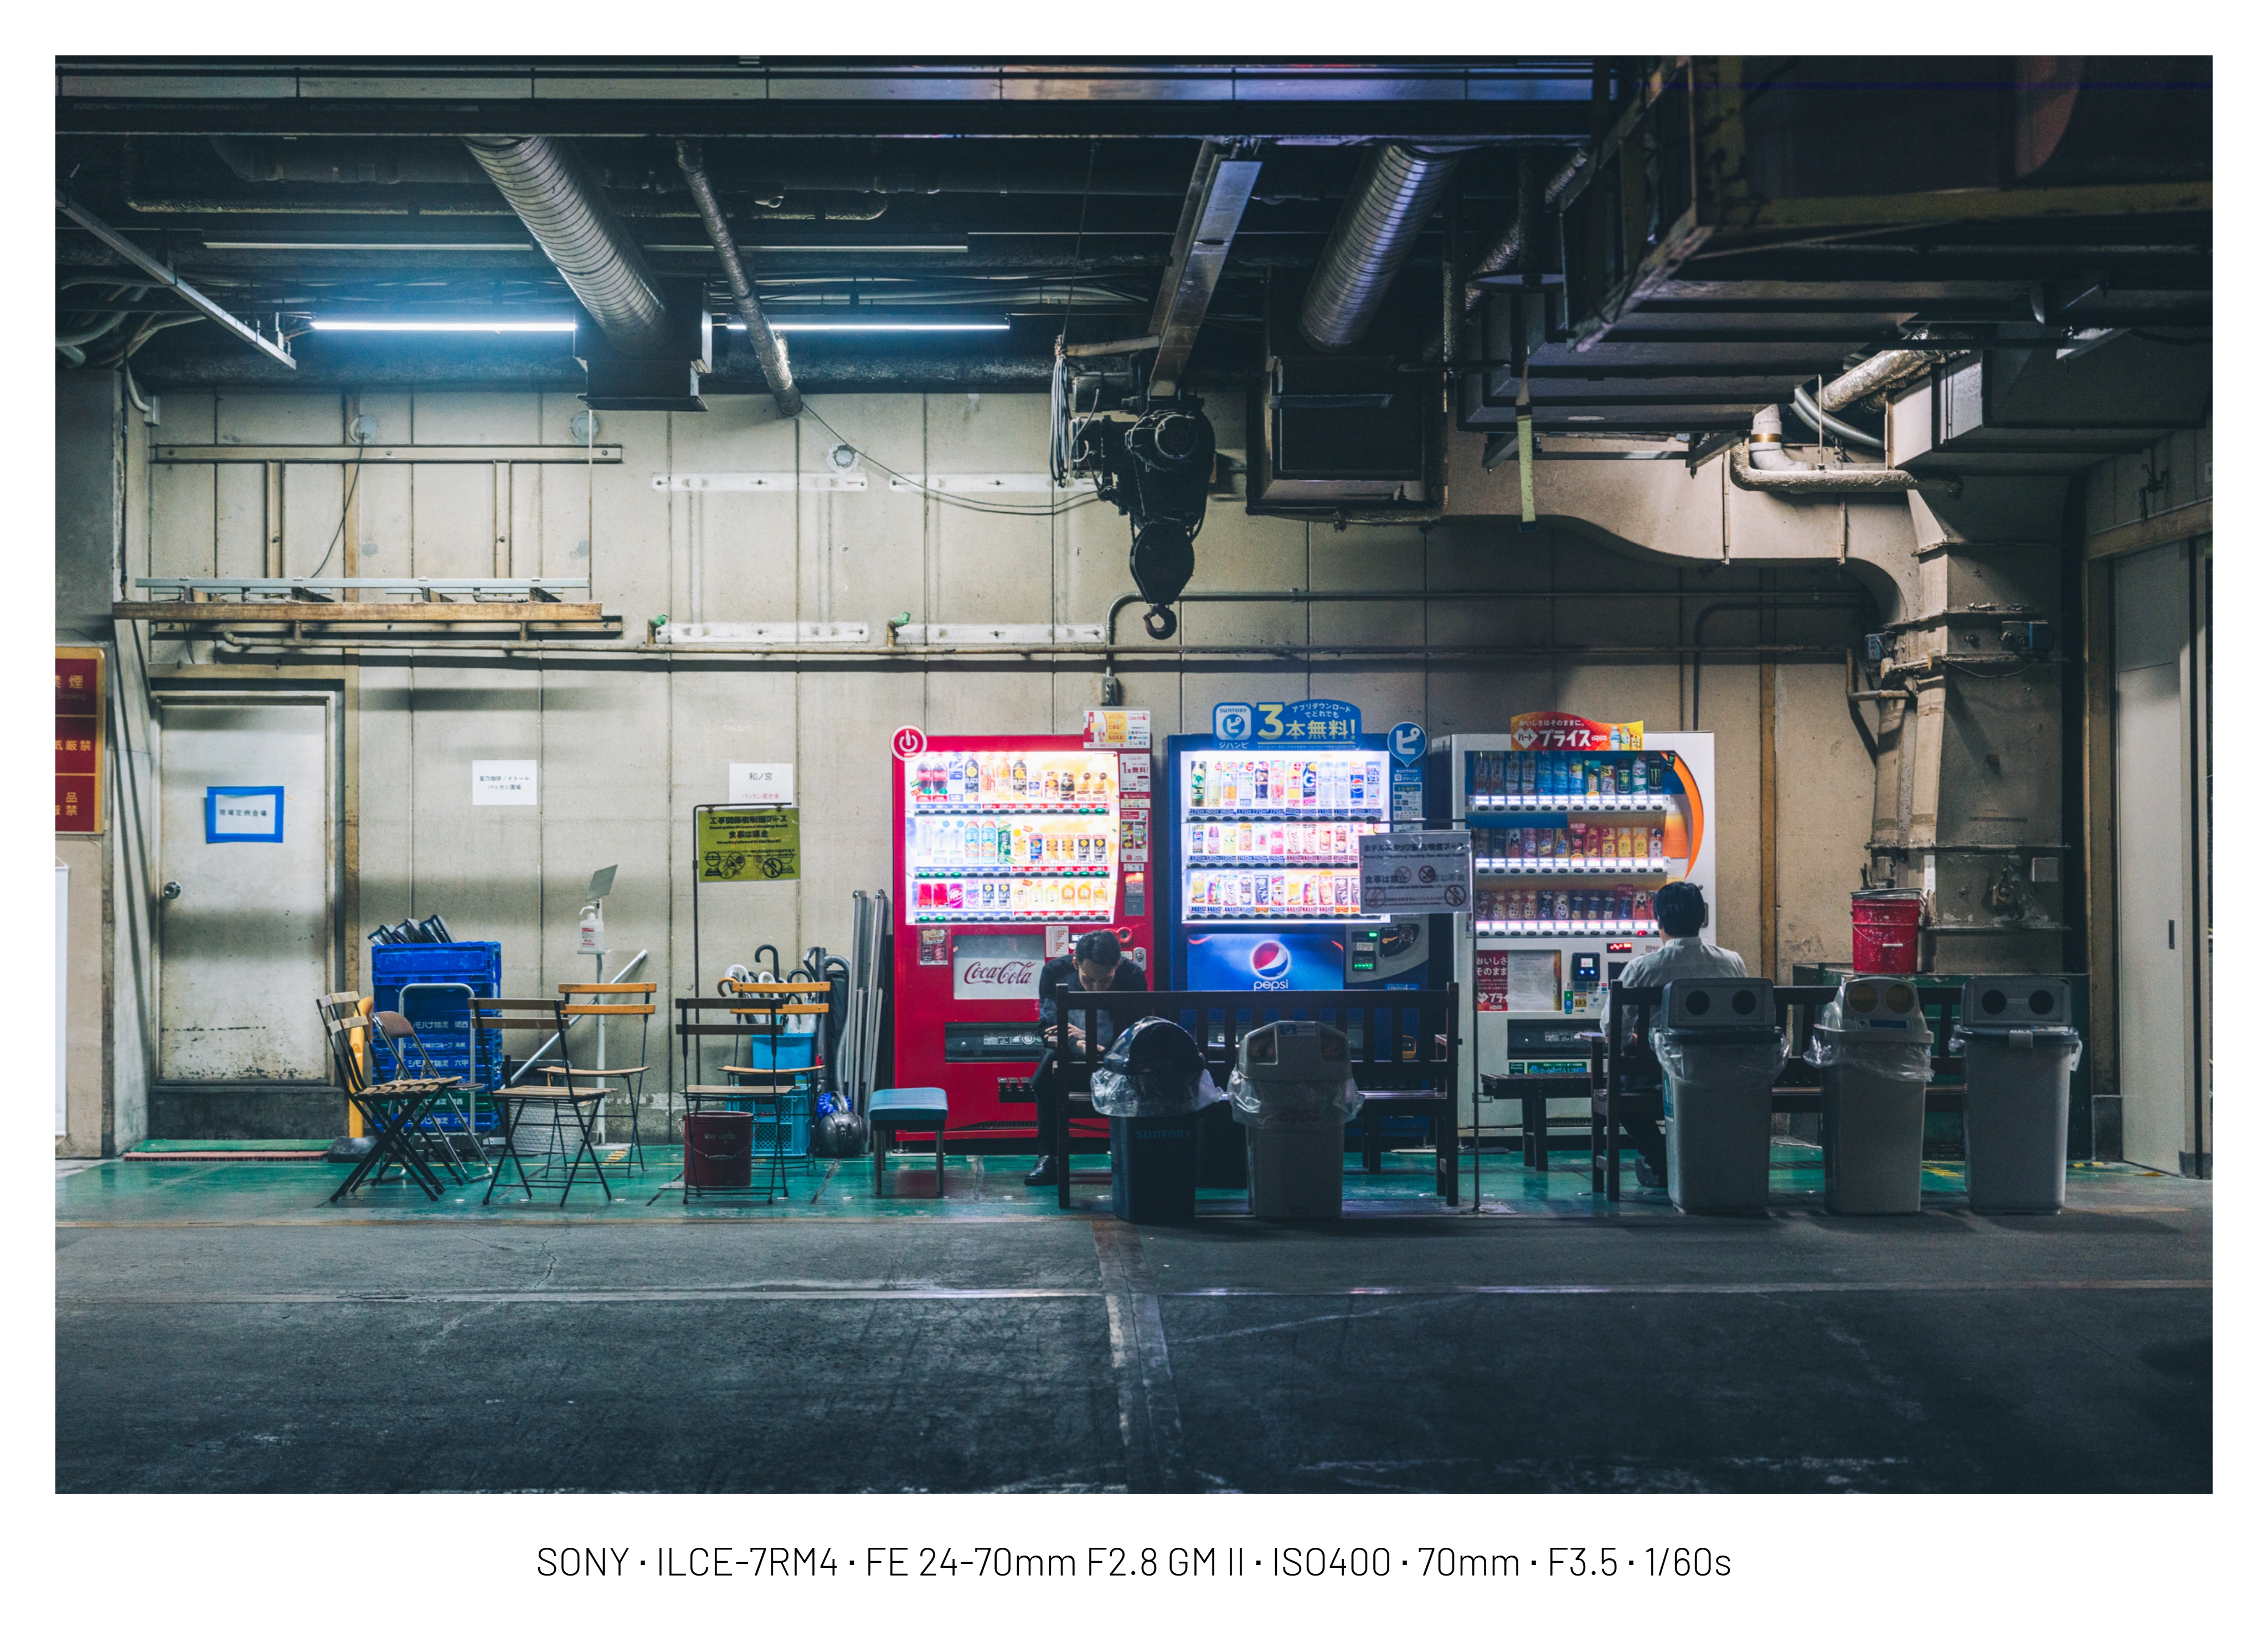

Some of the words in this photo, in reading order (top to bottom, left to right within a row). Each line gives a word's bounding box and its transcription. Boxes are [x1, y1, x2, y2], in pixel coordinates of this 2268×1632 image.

[1292, 702, 1351, 713] アプリダウンロード
[1539, 729, 1591, 747] プライス
[749, 772, 773, 781] 和ノ宮
[66, 792, 77, 803] 品
[963, 961, 1037, 985] Coca-Cola
[1253, 979, 1288, 991] pepsi
[1136, 1129, 1192, 1139] SUNTORY
